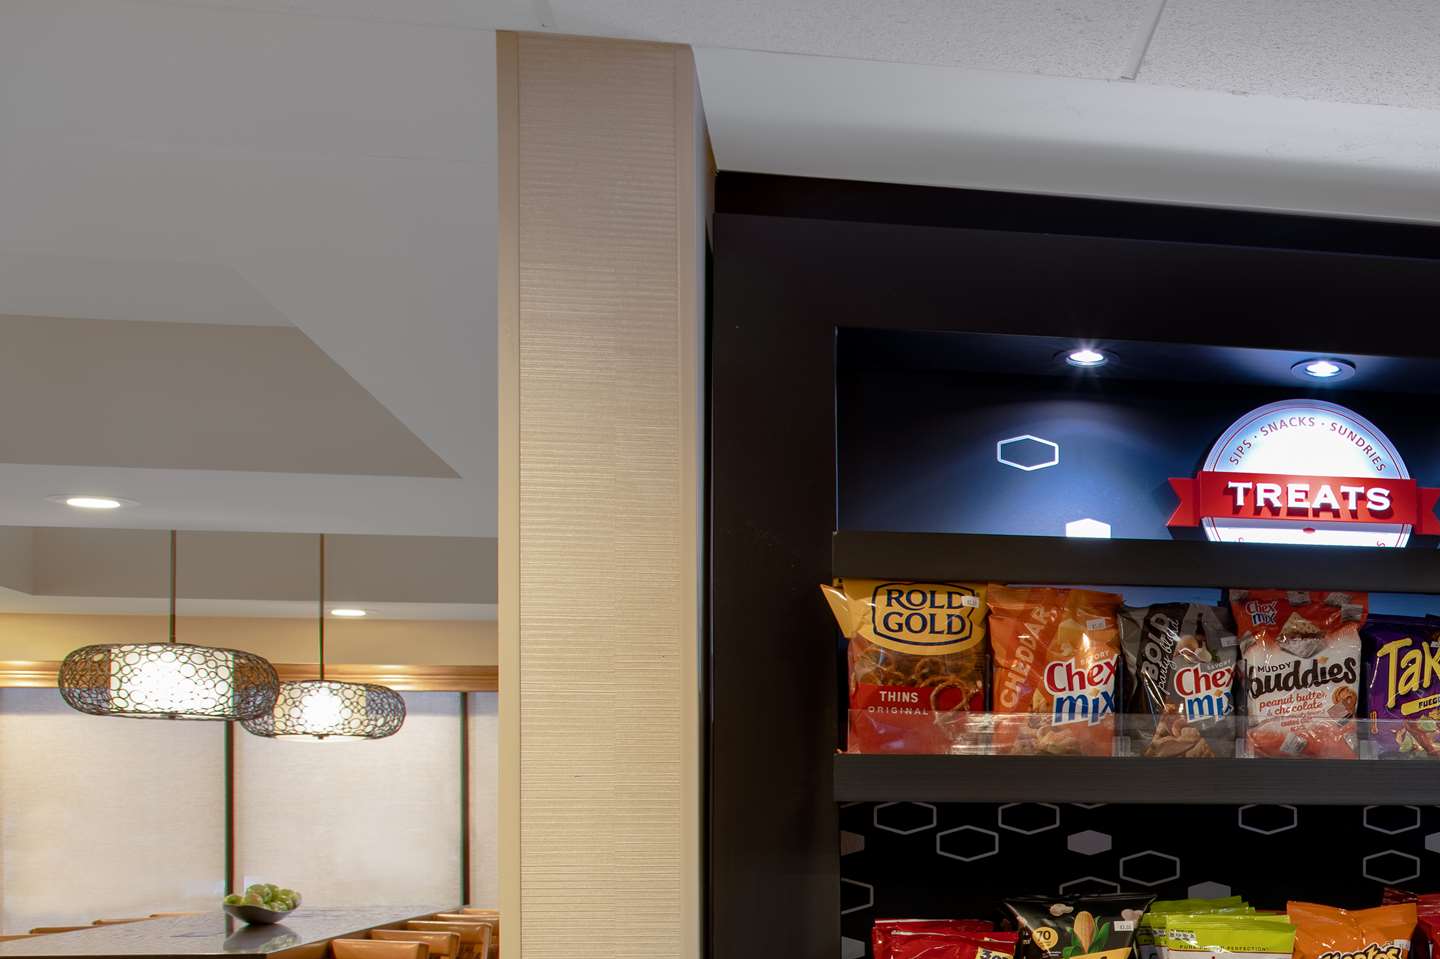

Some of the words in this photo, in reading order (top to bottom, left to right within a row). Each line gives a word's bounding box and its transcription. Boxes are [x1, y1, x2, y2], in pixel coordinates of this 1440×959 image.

[1228, 438, 1253, 467] SIPS
[1259, 415, 1317, 437] SNACKS
[1330, 421, 1388, 473] SUNDRIES
[1227, 480, 1392, 512] TREATS
[885, 588, 967, 610] ROLD
[882, 611, 967, 635] GOLD
[1141, 613, 1170, 681] BOLD
[1045, 658, 1119, 694] Chex
[1248, 657, 1357, 699] buddies
[1257, 662, 1292, 673] MUDDY
[1174, 666, 1234, 697] Chex
[867, 705, 929, 716] ORIGINAL
[879, 690, 919, 704] THINS
[1054, 690, 1116, 724] mix
[1260, 694, 1294, 712] peanut
[1036, 930, 1051, 941] 70
